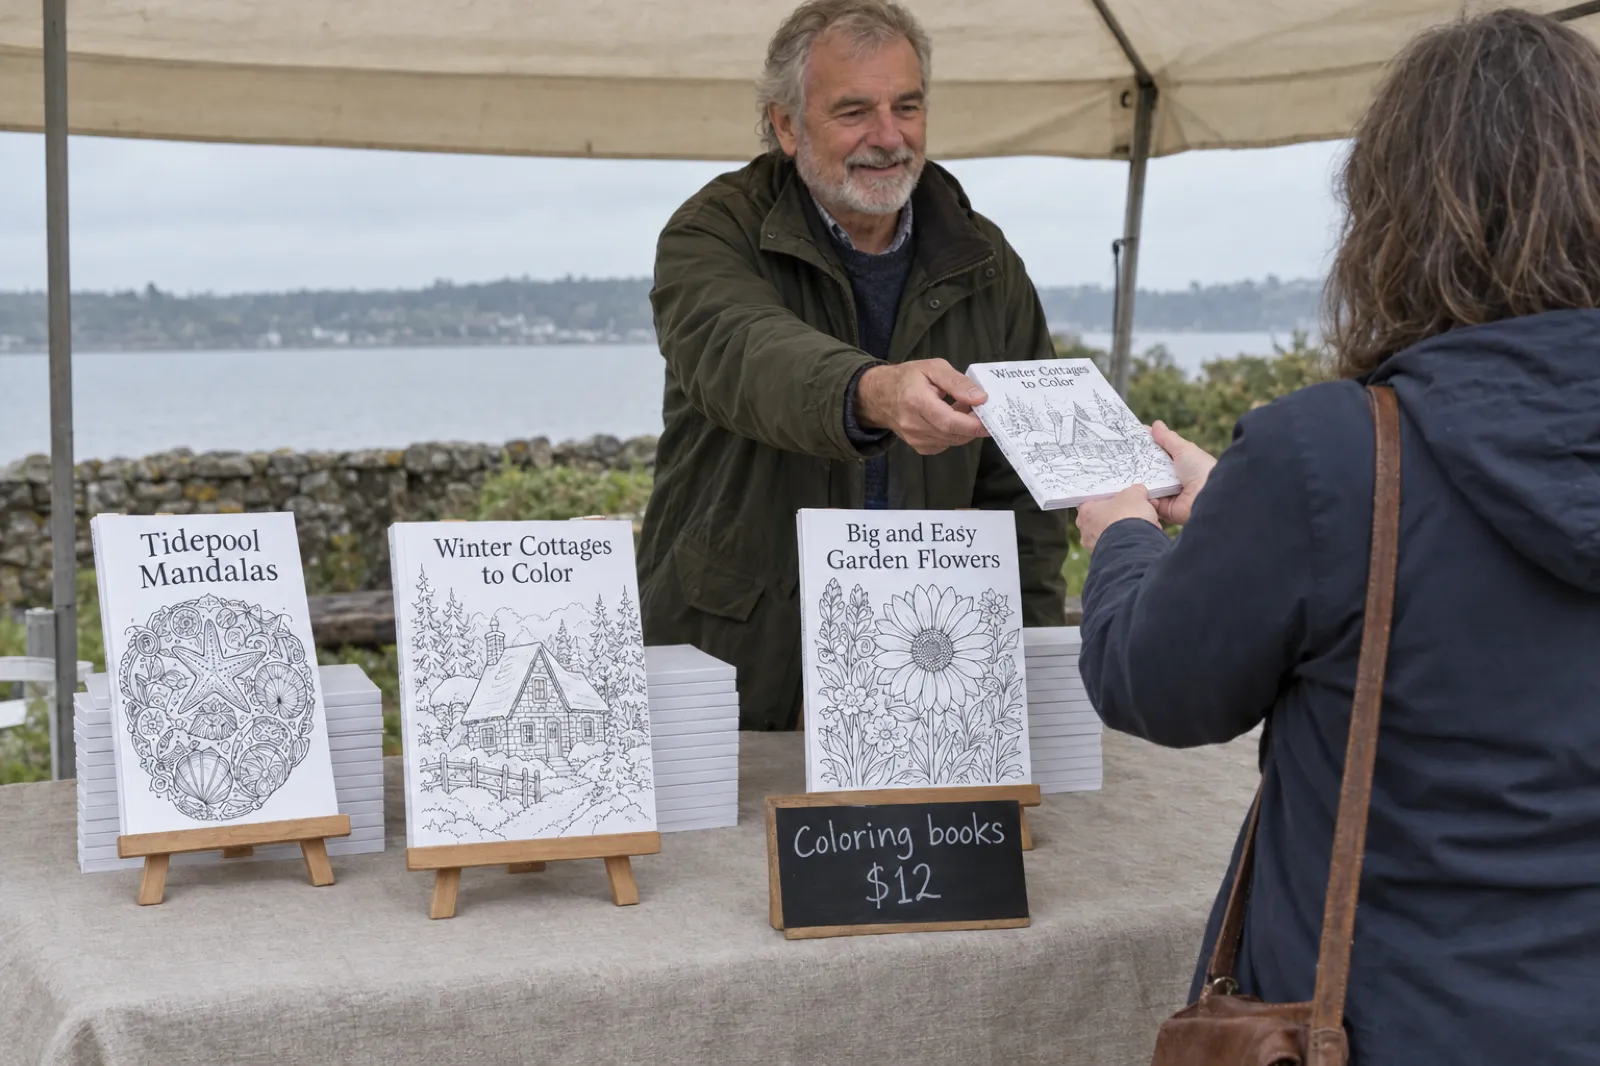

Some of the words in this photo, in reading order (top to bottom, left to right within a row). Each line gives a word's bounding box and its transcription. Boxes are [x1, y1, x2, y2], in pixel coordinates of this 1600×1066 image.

[989, 367, 1036, 379] Winter
[1038, 366, 1090, 377] Cottages
[1021, 380, 1036, 389] to
[1038, 376, 1075, 388] Color
[139, 527, 261, 558] Tidepool
[433, 537, 513, 559] Winter
[519, 535, 613, 562] Cottages
[846, 523, 881, 549] Big
[885, 521, 925, 543] and
[930, 522, 978, 548] Easy
[826, 548, 910, 570] Garden
[917, 548, 1001, 569] Flowers
[139, 557, 279, 589] Mandalas
[481, 566, 505, 585] to
[511, 562, 574, 584] Color
[793, 819, 914, 860] Coloring
[927, 811, 1005, 846] books
[865, 861, 942, 910] $12
